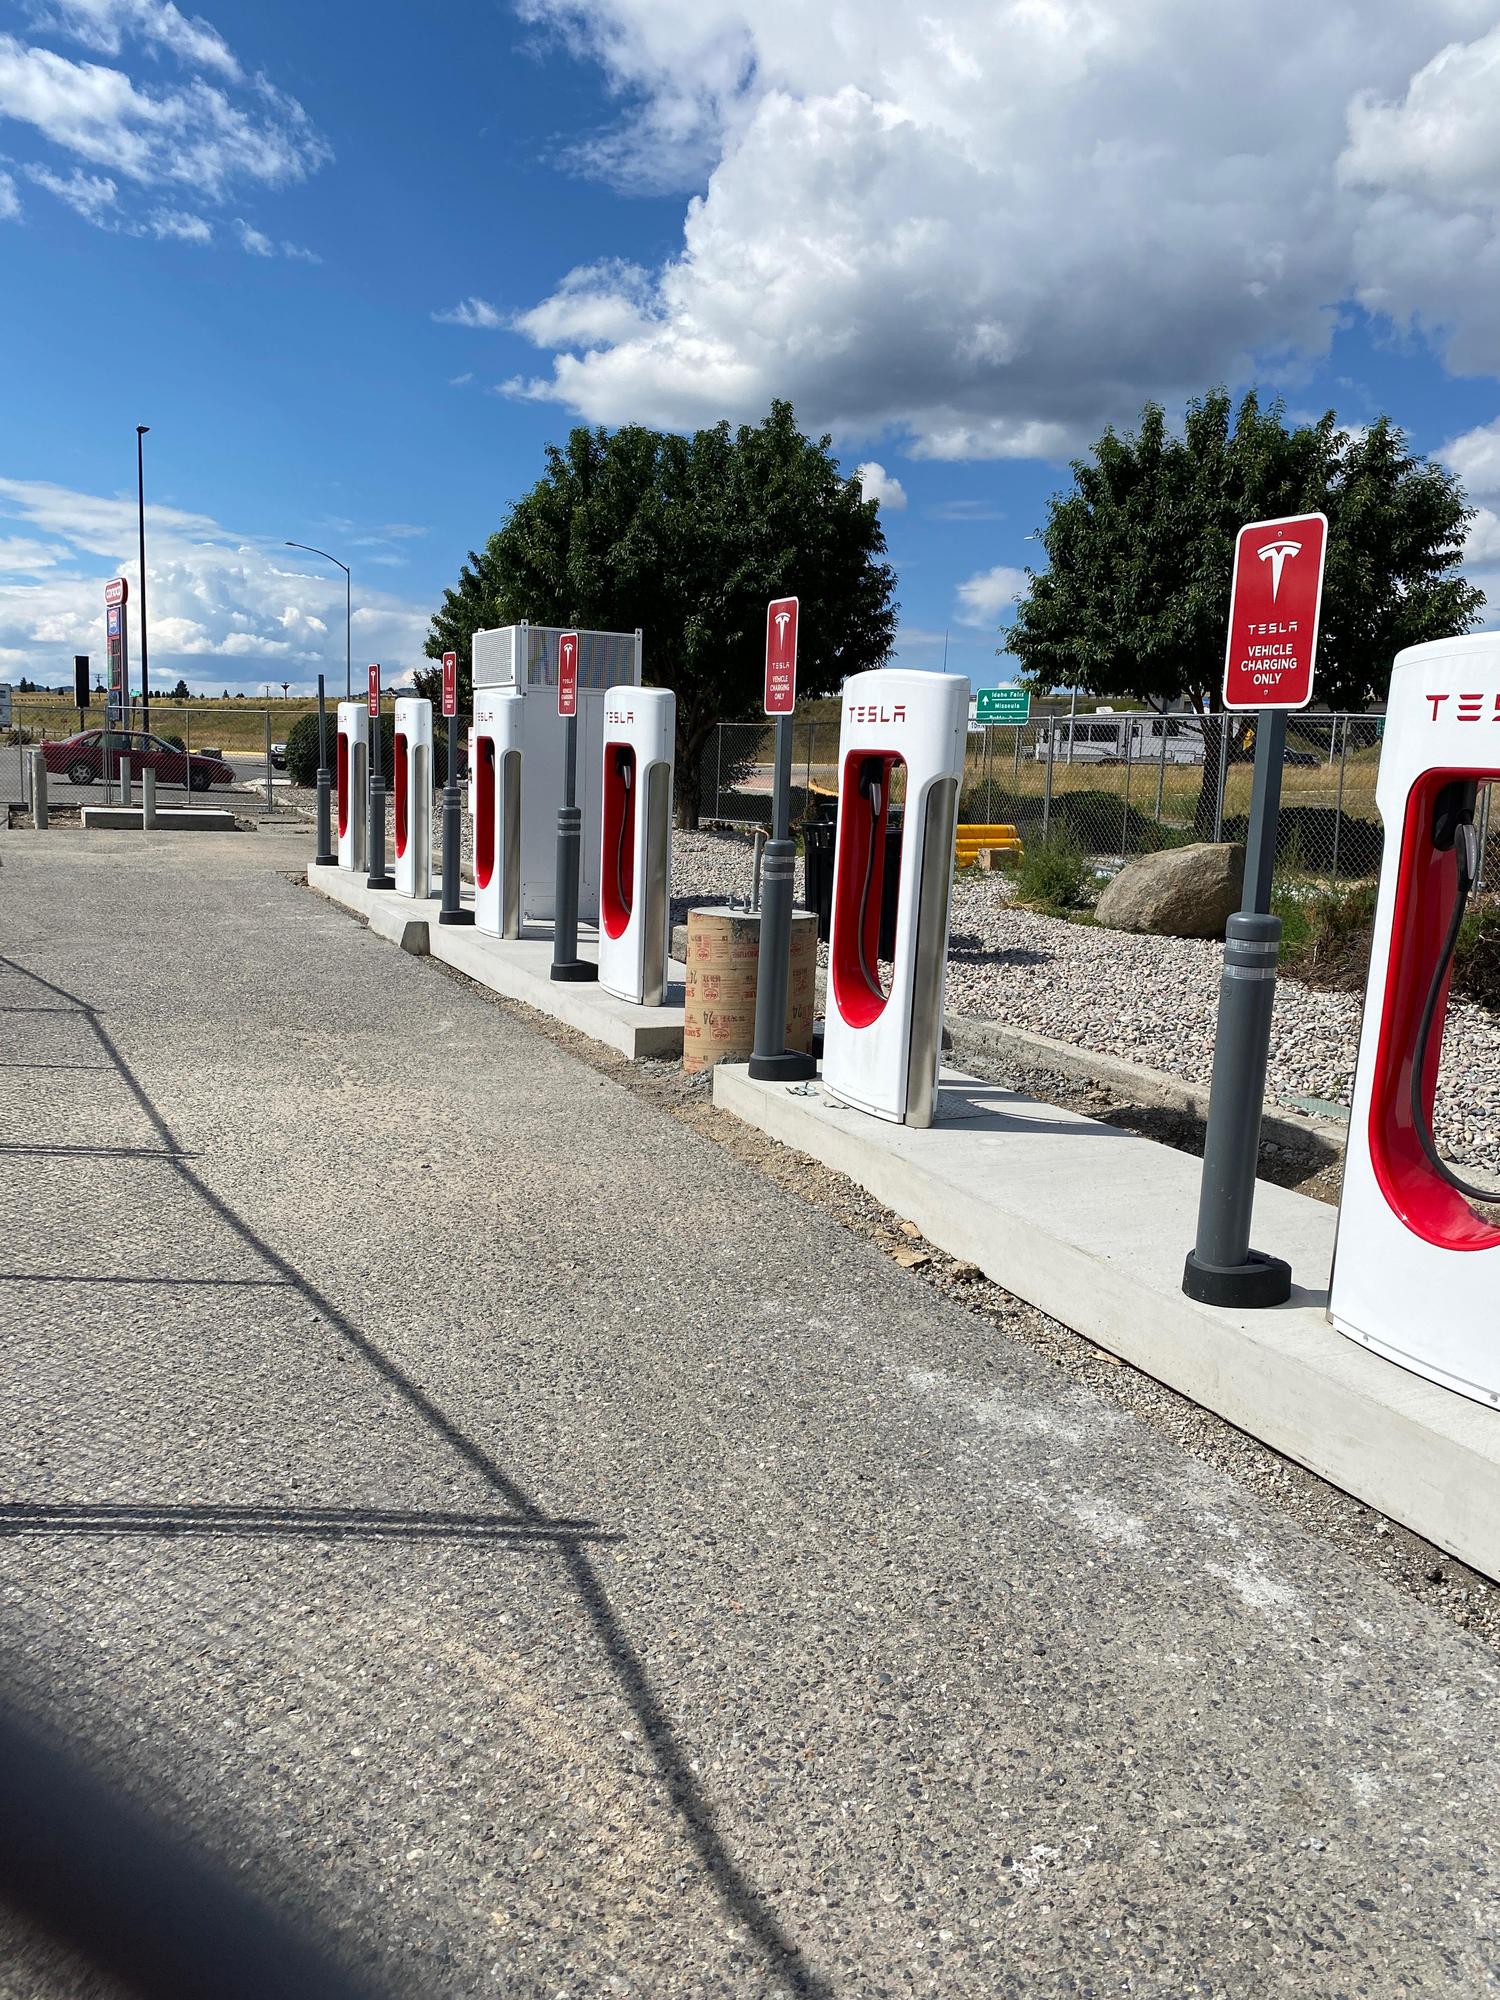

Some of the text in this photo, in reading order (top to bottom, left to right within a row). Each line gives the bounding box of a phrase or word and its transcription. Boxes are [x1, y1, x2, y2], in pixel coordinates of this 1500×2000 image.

[1248, 621, 1298, 635] TESLA
[1248, 643, 1293, 657] VEHICLE
[772, 661, 790, 670] TESLA
[1241, 657, 1298, 672] CHARGING
[1253, 672, 1282, 685] ONLY
[849, 705, 906, 723] TESLA
